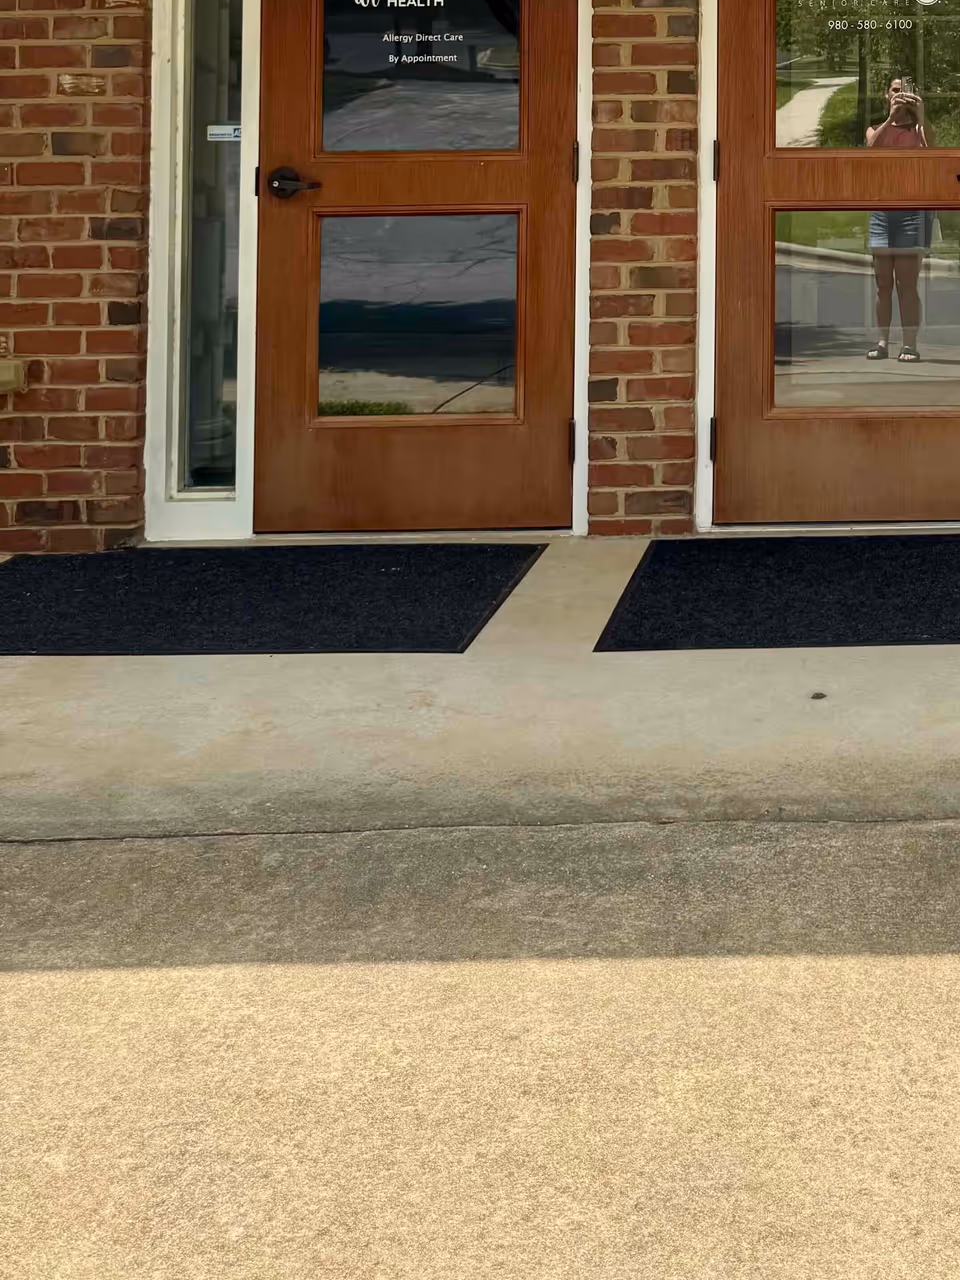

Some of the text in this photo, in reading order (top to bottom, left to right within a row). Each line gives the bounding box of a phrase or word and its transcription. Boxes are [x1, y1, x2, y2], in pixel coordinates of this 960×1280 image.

[870, 0, 910, 7] CARE
[828, 20, 849, 30] 980
[857, 20, 877, 30] 580
[885, 19, 913, 30] 6100
[382, 33, 464, 43] Allergy Direct Care
[388, 54, 457, 63] By Appointment
